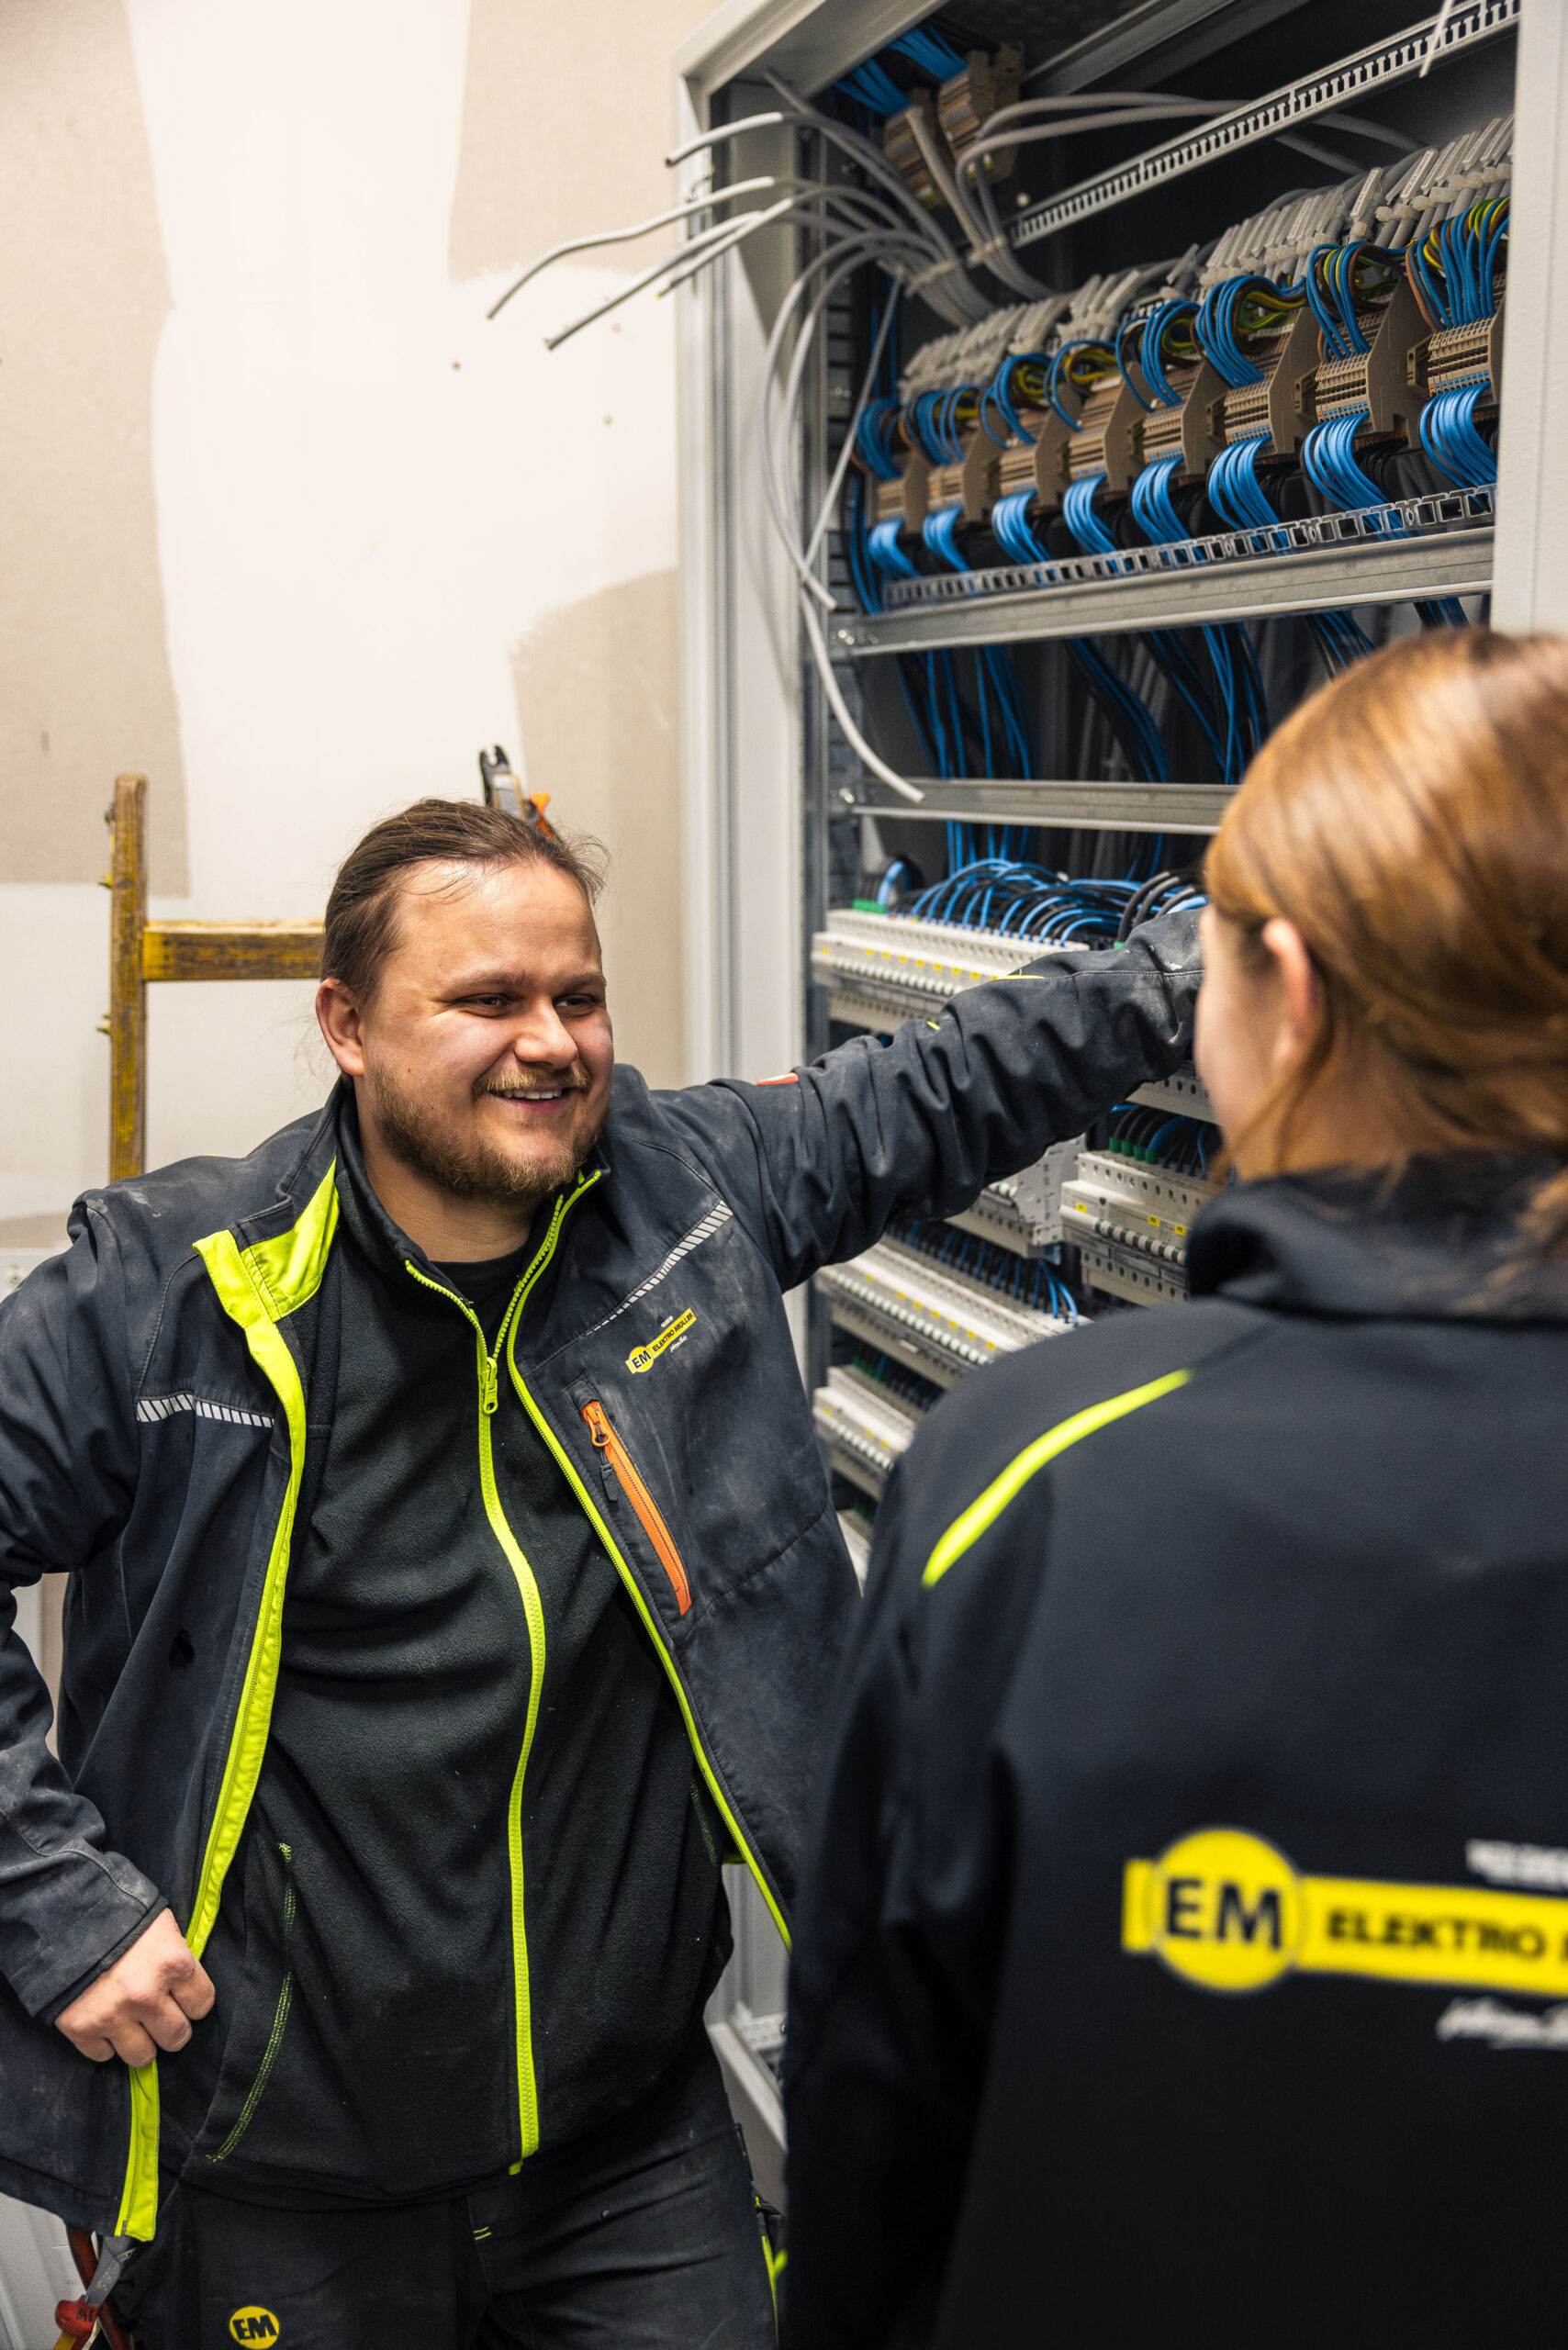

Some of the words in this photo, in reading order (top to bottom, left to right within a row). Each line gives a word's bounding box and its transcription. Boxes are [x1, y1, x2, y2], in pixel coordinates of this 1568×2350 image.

[632, 1350, 652, 1369] EM
[653, 1329, 675, 1352] ELEKTRO
[1166, 1877, 1282, 1950] EM
[1326, 1908, 1547, 1961] ELEKTRO
[232, 2313, 278, 2341] EM
